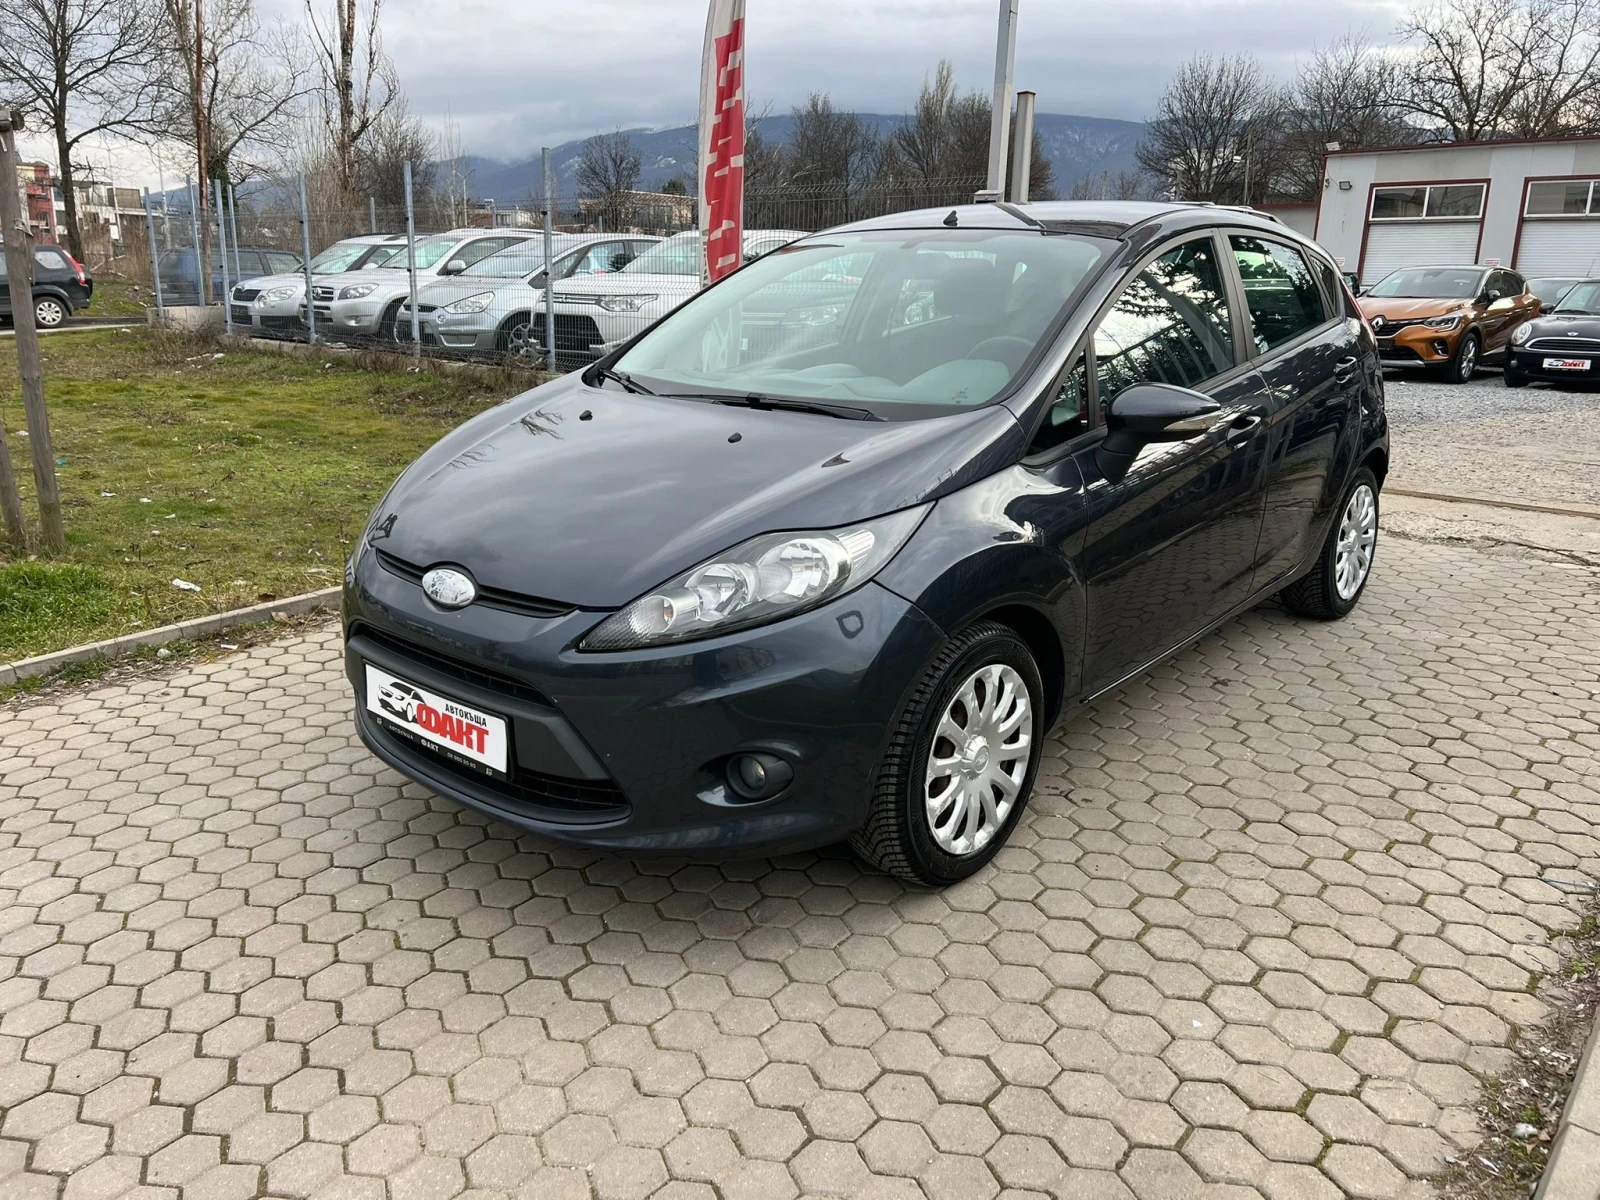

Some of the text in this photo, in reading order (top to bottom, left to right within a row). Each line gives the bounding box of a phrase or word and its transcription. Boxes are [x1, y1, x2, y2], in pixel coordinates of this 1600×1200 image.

[445, 703, 487, 727] АВТОКЪЩА
[417, 703, 489, 754] ФАКТ
[421, 739, 439, 752] ФАКТ
